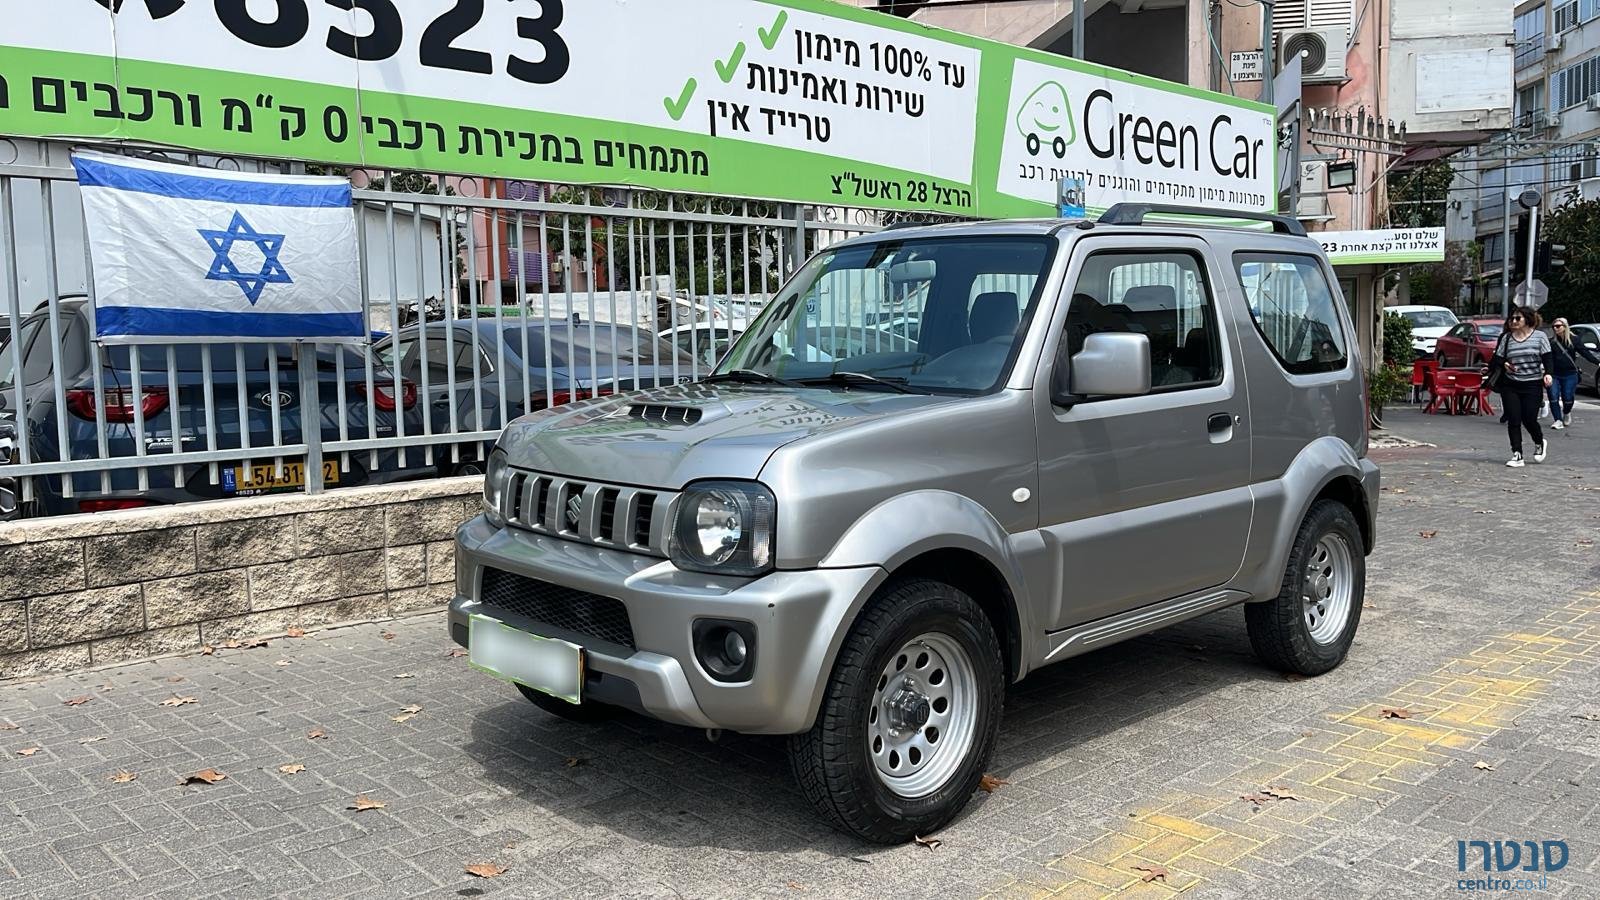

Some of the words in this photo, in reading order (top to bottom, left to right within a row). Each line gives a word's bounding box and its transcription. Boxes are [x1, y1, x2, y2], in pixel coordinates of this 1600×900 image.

[794, 29, 860, 68] מימון
[869, 41, 932, 81] 100%
[746, 62, 847, 106] ואמינות
[938, 60, 966, 89] עד
[32, 76, 203, 128] ורכבים
[855, 86, 925, 118] שירות
[322, 104, 348, 144] 0
[706, 99, 750, 136] אין
[759, 106, 832, 143] טרייד
[360, 115, 447, 153] רכבי
[458, 126, 584, 165] במכירת
[1083, 89, 1199, 172] Green
[1209, 114, 1264, 181] Car
[594, 139, 709, 176] מתמחים
[1019, 163, 1044, 180] רכב
[906, 180, 928, 203] 28
[932, 182, 971, 207] הרצל
[1099, 174, 1140, 192] והוגנים
[1145, 180, 1195, 200] מתקדמים
[1199, 187, 1225, 203] מימון
[1228, 190, 1265, 206] פתרונות
[1341, 244, 1368, 252] אחרת
[1371, 243, 1392, 253] קצת
[1395, 243, 1407, 251] זה
[1410, 240, 1438, 250] אצלנו
[1415, 231, 1438, 240] שלם
